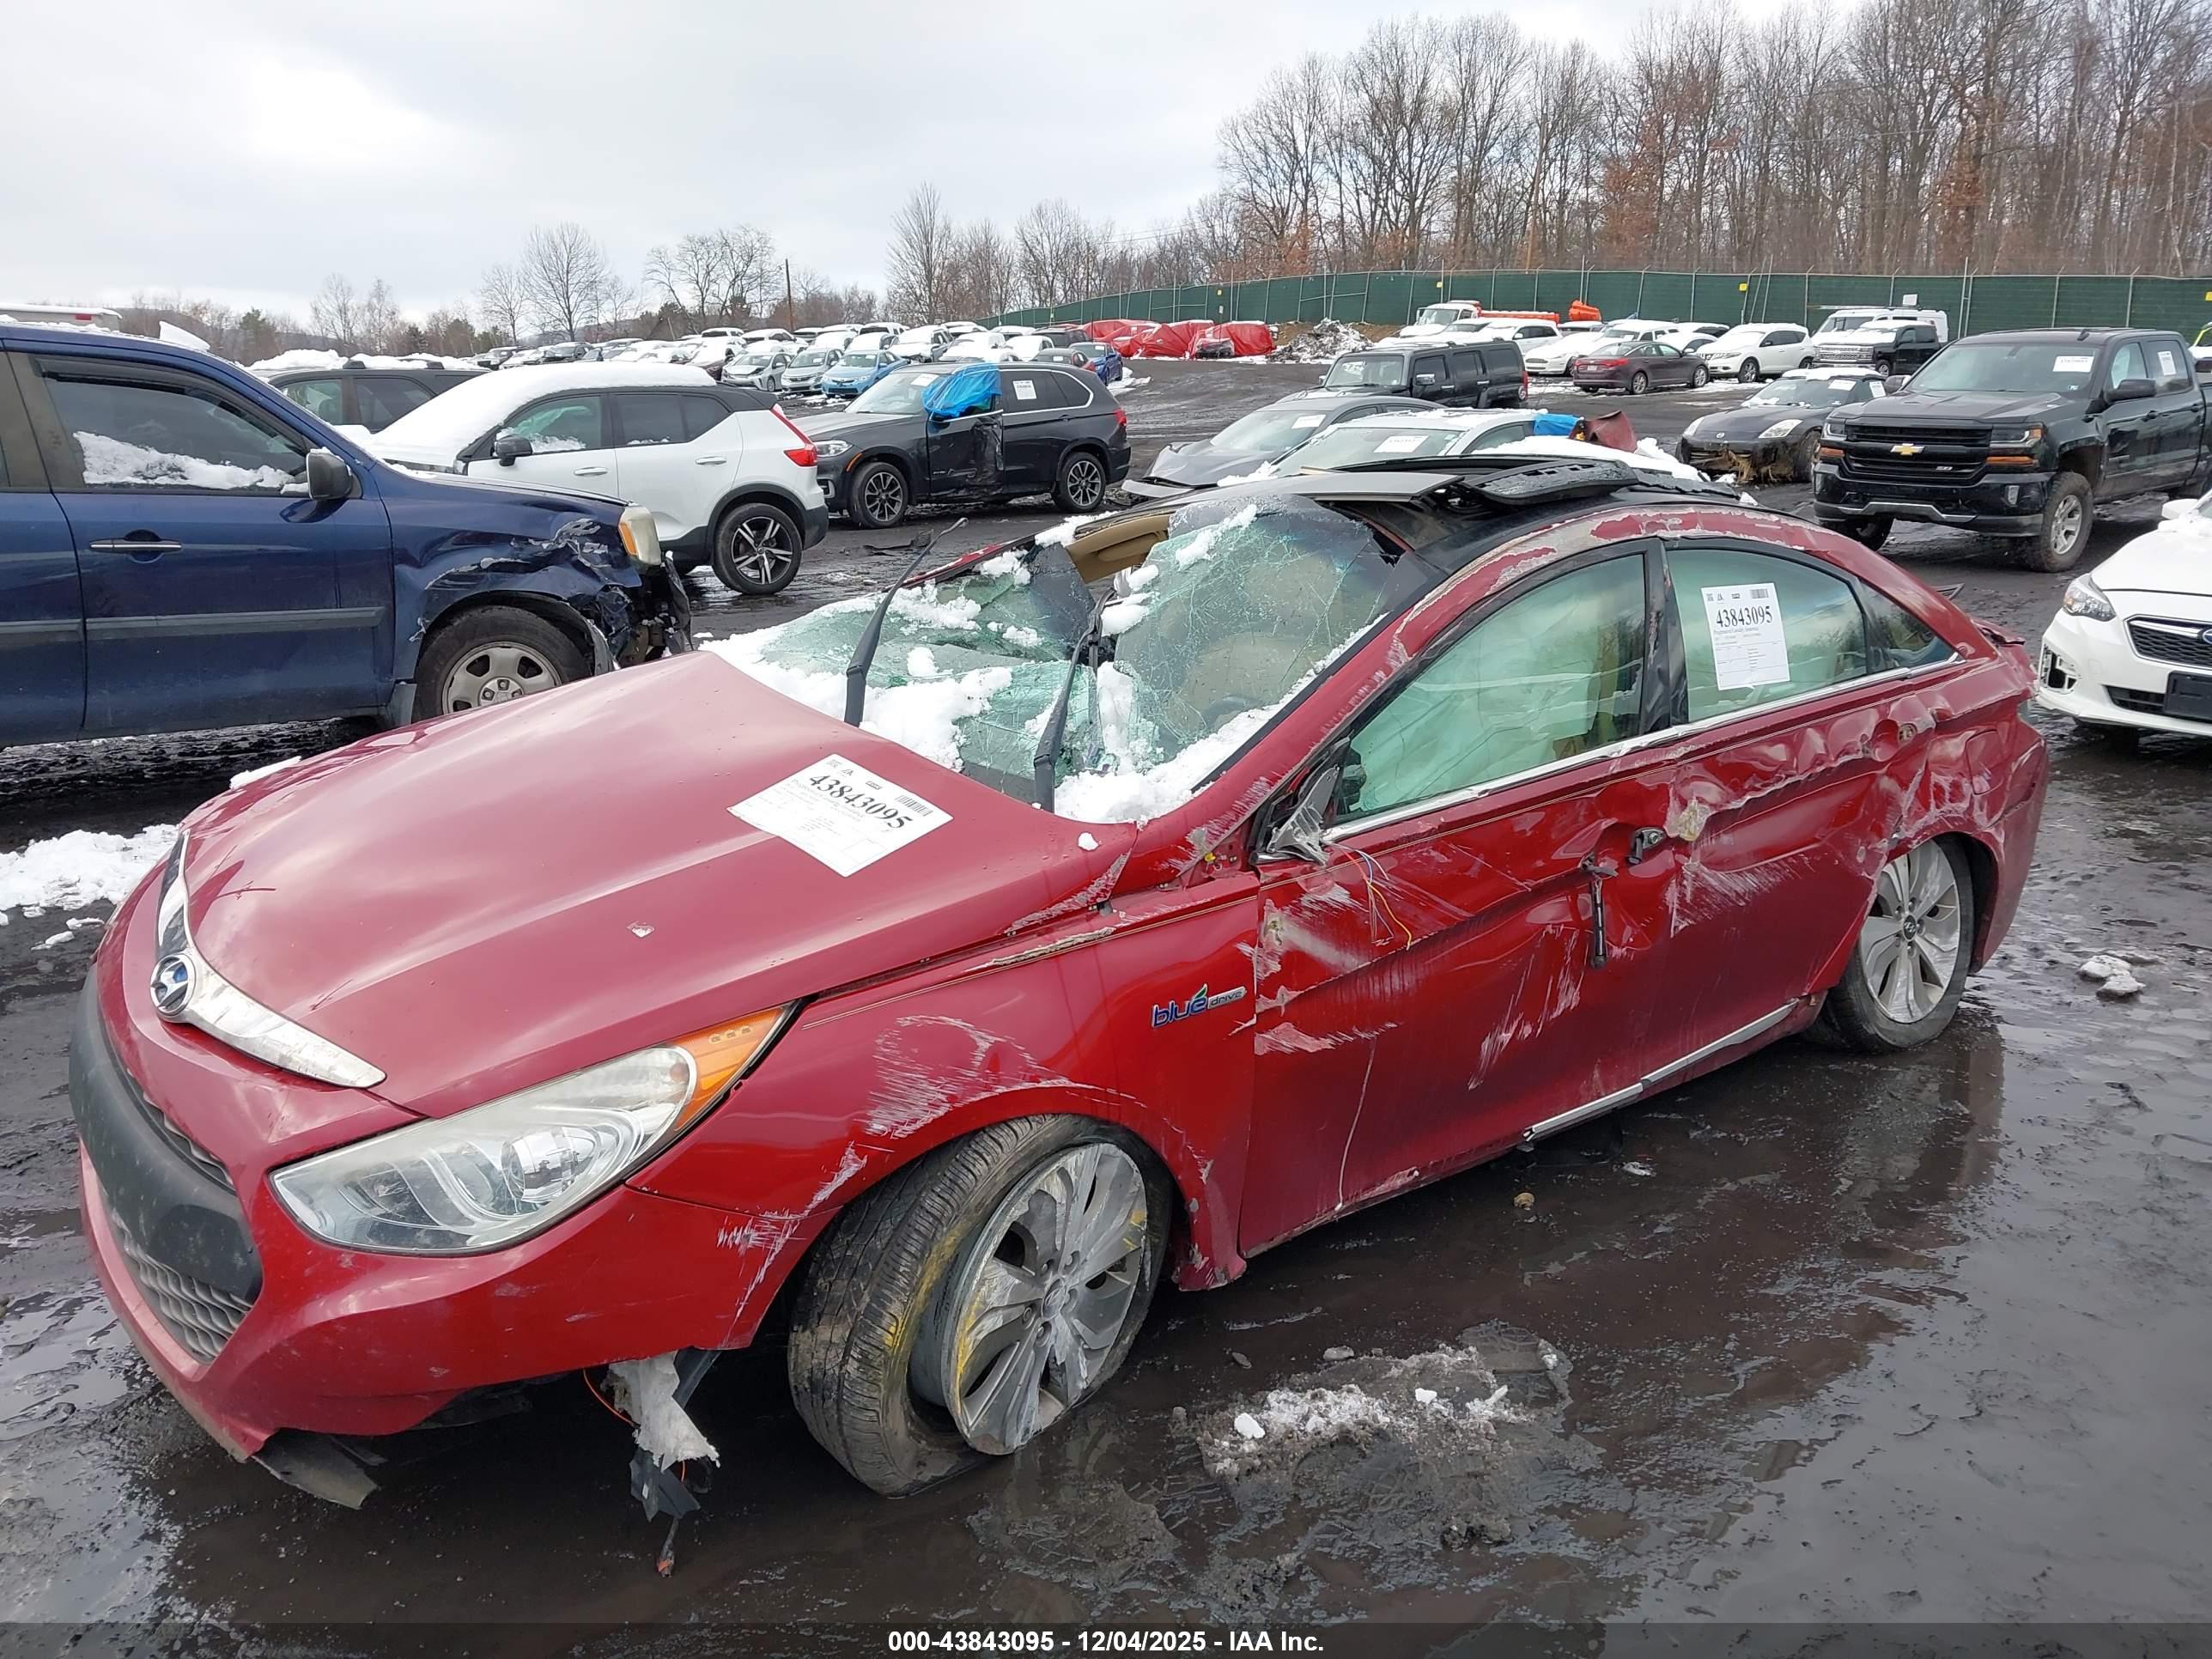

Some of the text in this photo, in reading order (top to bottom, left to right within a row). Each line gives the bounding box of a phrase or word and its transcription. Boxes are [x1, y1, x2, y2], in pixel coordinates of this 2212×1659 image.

[1716, 605, 1773, 628] 43843095
[809, 775, 914, 829] 43843095
[1210, 989, 1243, 1007] drive
